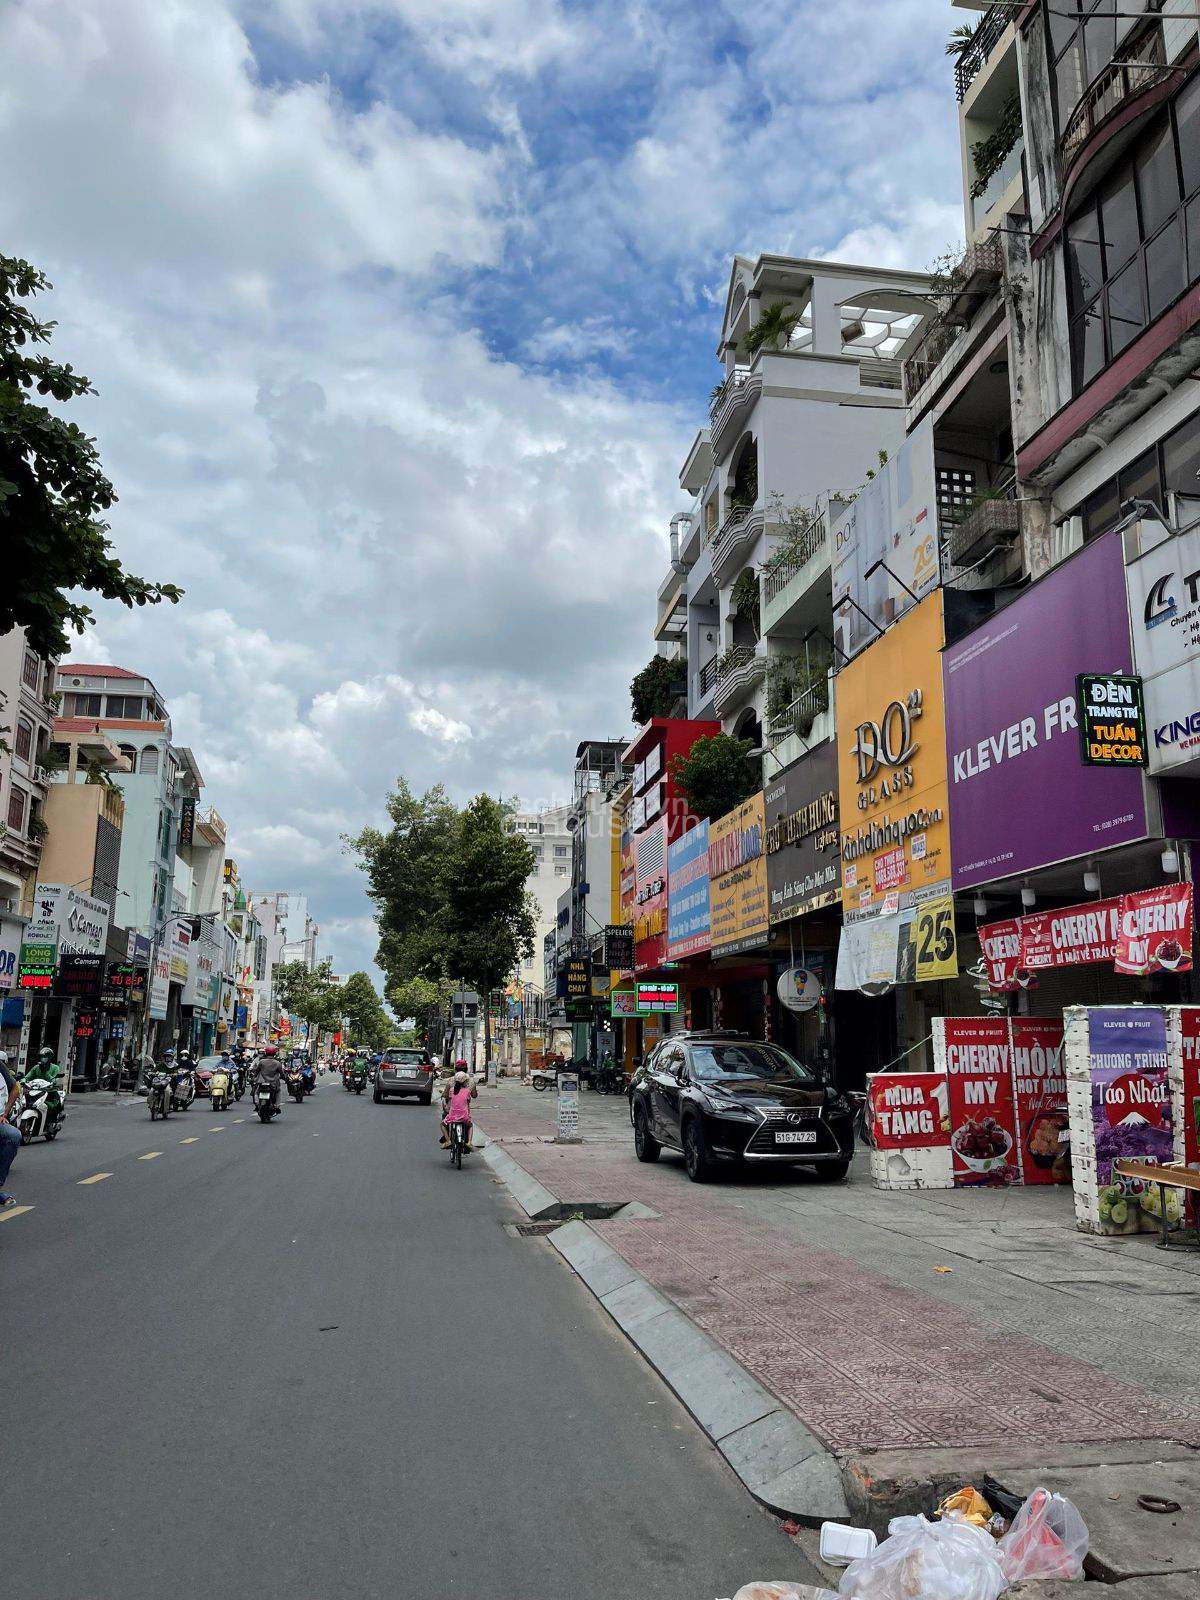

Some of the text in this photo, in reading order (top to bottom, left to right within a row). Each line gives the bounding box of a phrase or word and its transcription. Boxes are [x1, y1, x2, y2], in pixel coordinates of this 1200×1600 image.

[1171, 610, 1196, 627] Chuyên
[1091, 681, 1133, 703] ĐÈN
[1087, 706, 1139, 719] TRANG TRÍ
[953, 717, 1038, 783] KLEVER
[1090, 744, 1142, 760] DECOR
[858, 765, 914, 810] GLASS
[815, 831, 837, 852] Lighting
[1051, 911, 1107, 949] CHERRY
[1123, 900, 1189, 938] CHERRY
[606, 929, 633, 939] SPELIER
[919, 909, 954, 963] 25
[26, 949, 51, 957] LONG
[985, 934, 1019, 960] CHERR
[1056, 950, 1063, 964] BÍ
[1080, 944, 1091, 960] VỀ
[1091, 944, 1109, 959] TRÁI
[570, 961, 584, 970] NHÀ
[568, 972, 587, 982] HÀNG
[568, 984, 586, 992] CHAY
[948, 1045, 1008, 1074] CHERRY
[964, 1077, 998, 1104] MỸ
[1017, 1079, 1040, 1093] HOT
[1096, 1080, 1169, 1108] Táo Nhật
[885, 1082, 949, 1124] MUA 1
[878, 1109, 934, 1140] TẶNG
